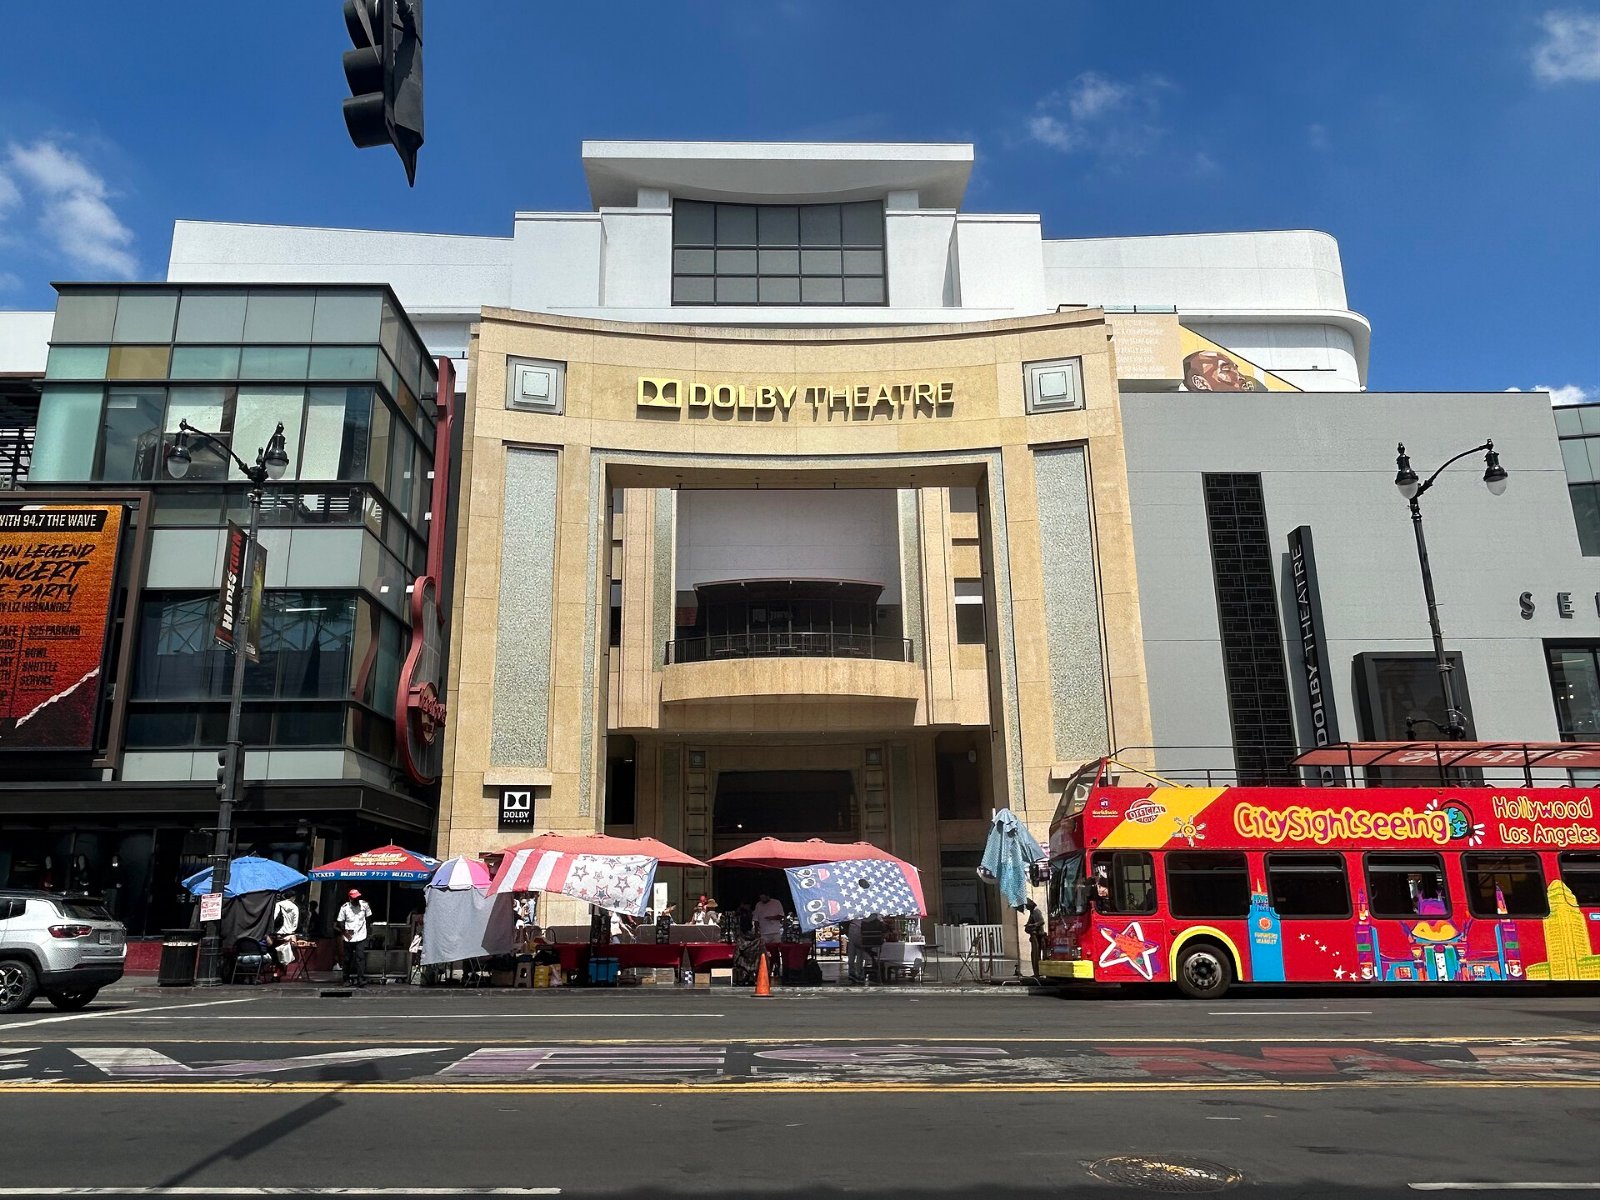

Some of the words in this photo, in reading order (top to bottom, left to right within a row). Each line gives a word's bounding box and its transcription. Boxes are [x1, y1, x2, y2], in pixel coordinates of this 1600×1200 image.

[689, 383, 797, 408] DOLBY
[806, 382, 954, 408] THEATRE
[23, 514, 45, 527] 94.7
[47, 514, 65, 527] THE
[68, 514, 97, 527] WAVE
[23, 543, 96, 559] LEGEND
[1291, 543, 1315, 657] THEATRE
[1309, 664, 1328, 747] DOLBY
[1492, 796, 1593, 821] Hollywood
[1499, 823, 1531, 844] Los
[1534, 823, 1600, 847] Angeles
